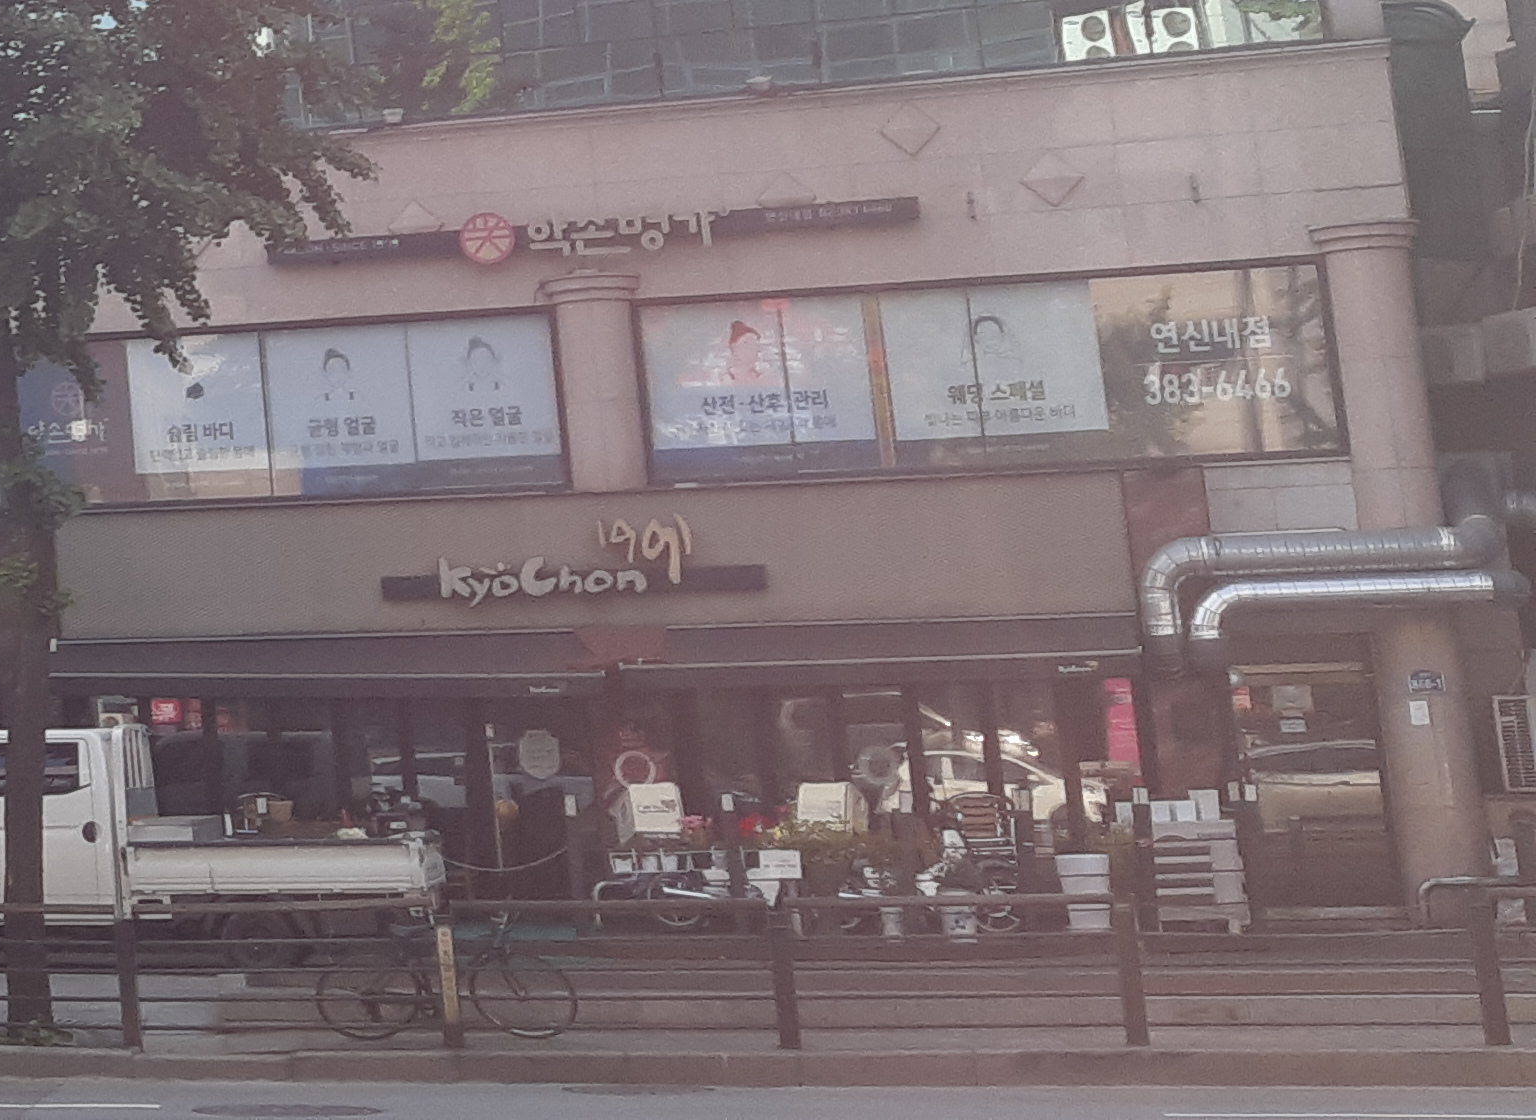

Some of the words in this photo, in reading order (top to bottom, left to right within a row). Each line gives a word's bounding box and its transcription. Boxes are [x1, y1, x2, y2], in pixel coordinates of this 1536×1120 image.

[1149, 315, 1273, 355] 연신내점
[792, 388, 830, 412] 관리
[202, 421, 235, 441] 바디
